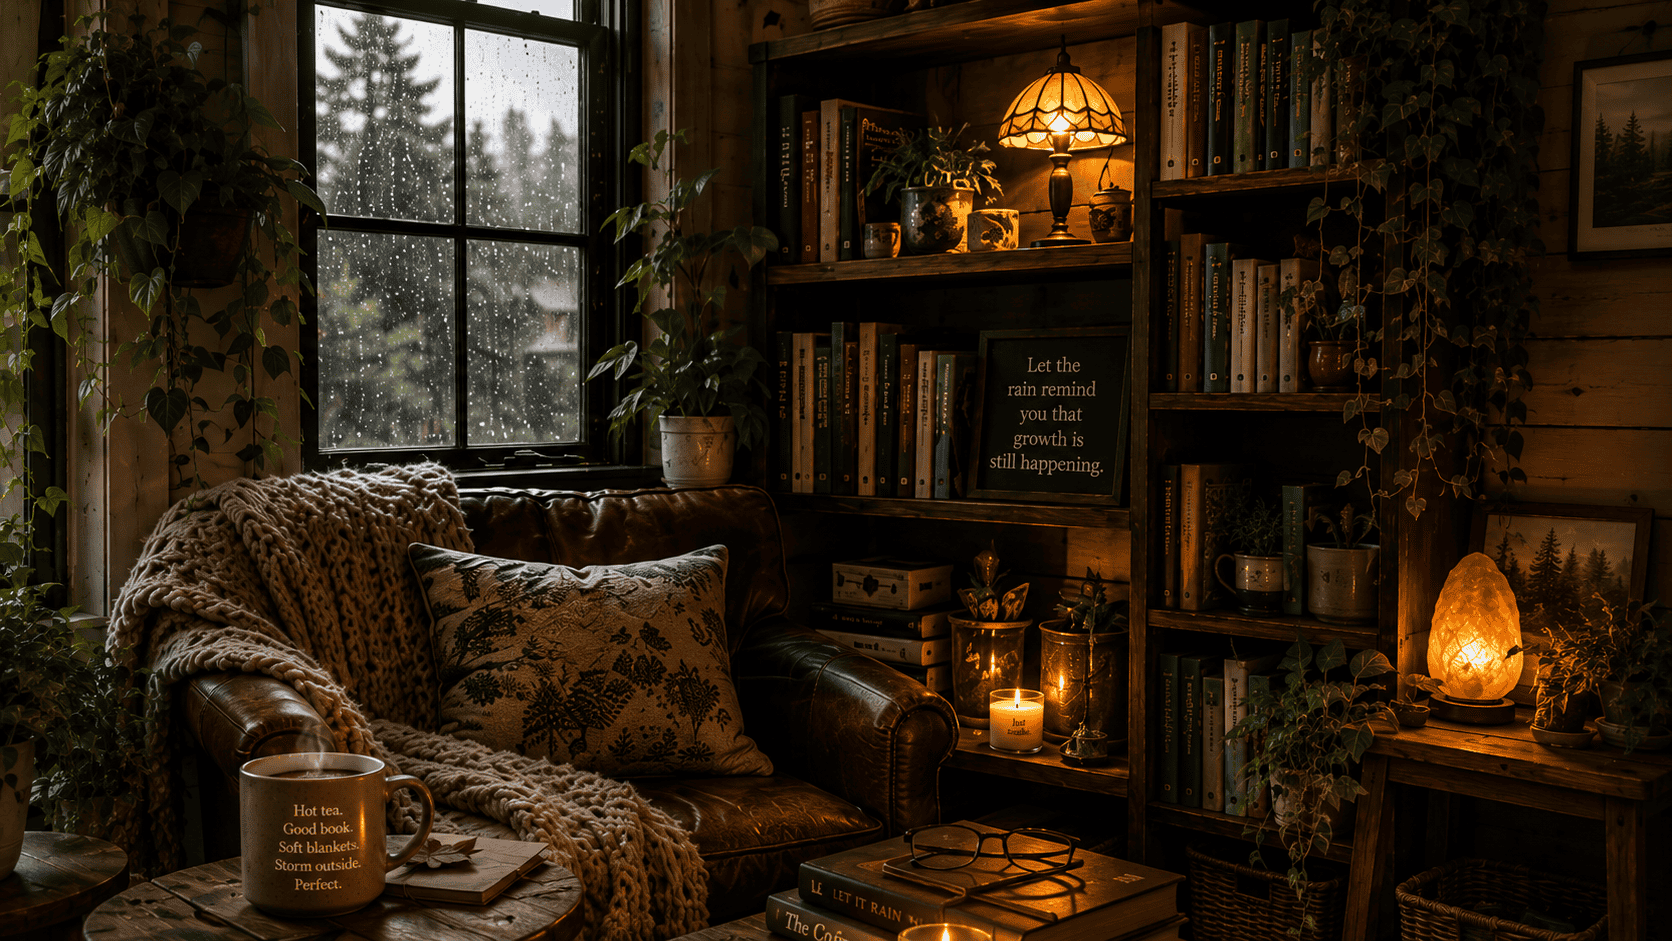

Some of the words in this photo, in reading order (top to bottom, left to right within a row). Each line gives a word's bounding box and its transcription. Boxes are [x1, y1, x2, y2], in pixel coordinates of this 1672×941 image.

[1027, 357, 1051, 373] Let
[1056, 356, 1081, 373] the
[1007, 381, 1037, 397] rain
[1041, 380, 1096, 397] remind
[1019, 408, 1047, 425] you
[1052, 405, 1083, 422] that
[1013, 430, 1067, 449] growth
[1071, 431, 1084, 448] is
[989, 453, 1016, 470] still
[1020, 453, 1104, 477] happening.
[293, 804, 317, 817] Hot
[321, 805, 343, 817] tea.
[283, 822, 317, 835] Good
[320, 821, 353, 835] book.
[278, 840, 303, 854] Soft
[306, 840, 360, 854] blankets.
[274, 859, 312, 872] Storm
[315, 857, 361, 872] outside.
[294, 878, 342, 891] Perfect.
[833, 888, 852, 904] LET
[855, 895, 867, 910] IT
[870, 901, 902, 923] RAIN
[785, 911, 809, 936] The
